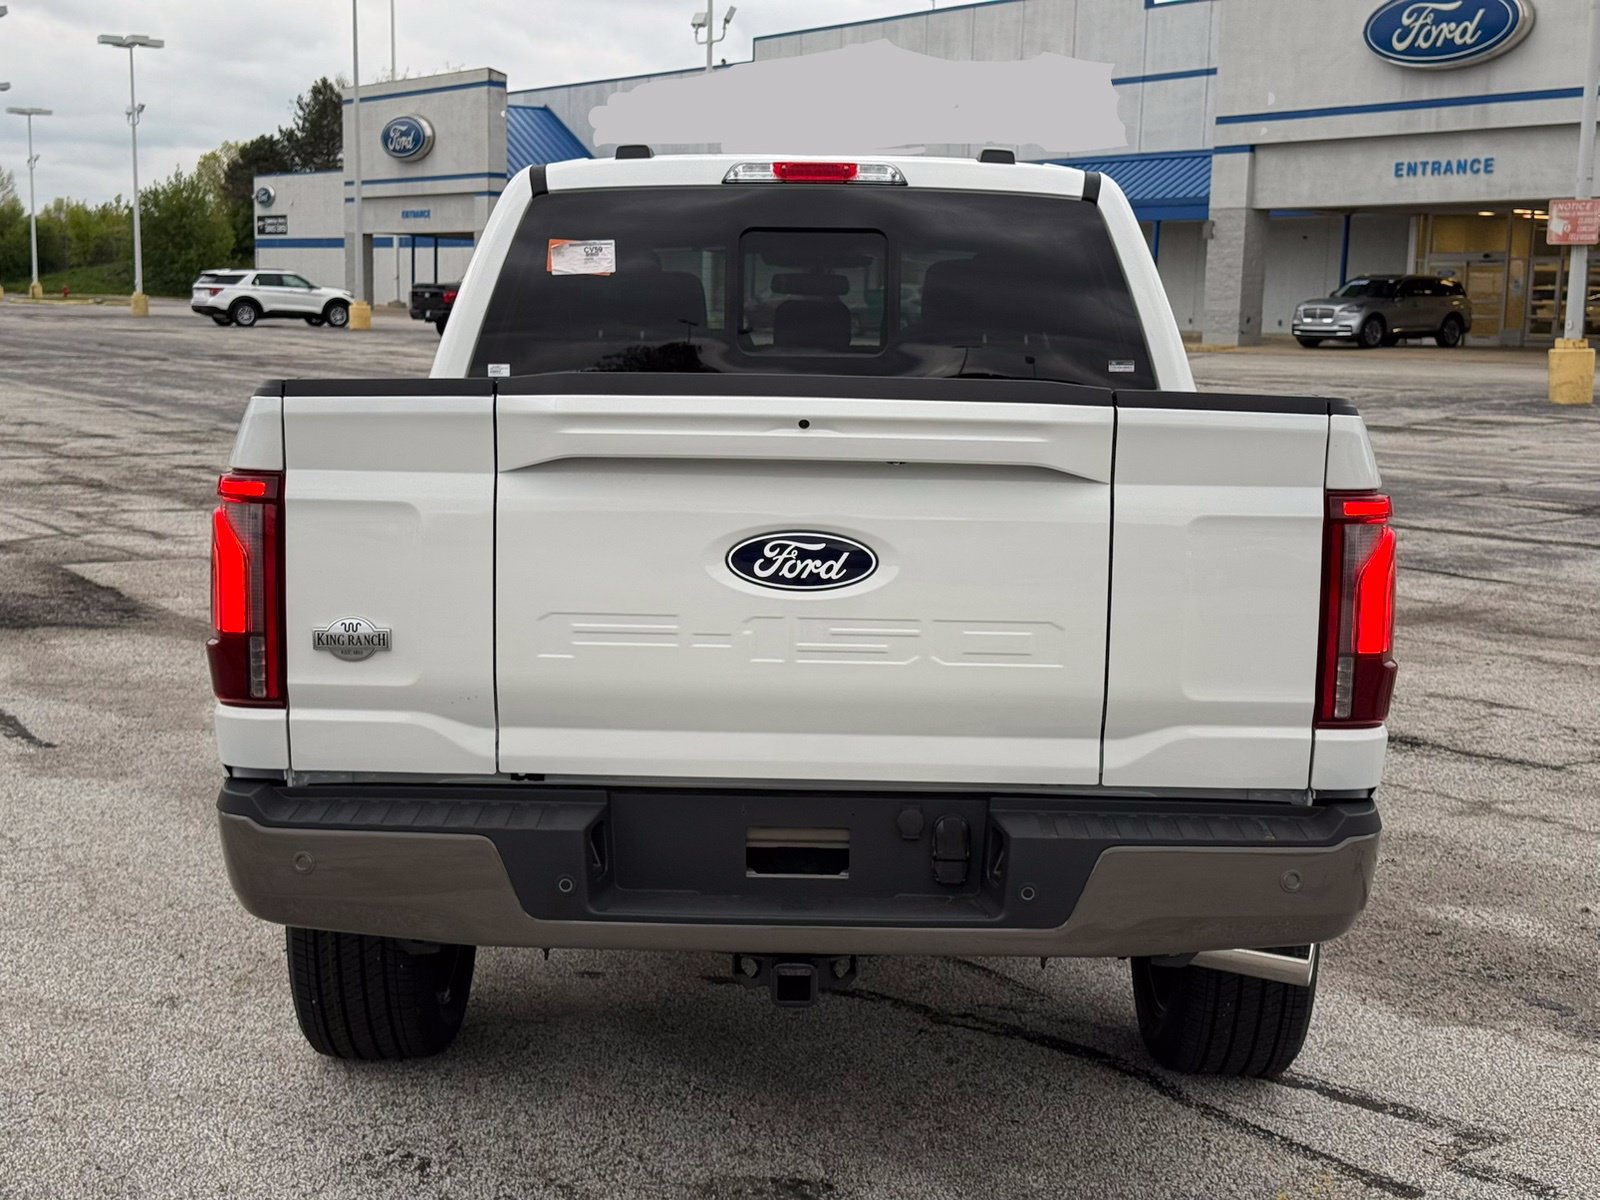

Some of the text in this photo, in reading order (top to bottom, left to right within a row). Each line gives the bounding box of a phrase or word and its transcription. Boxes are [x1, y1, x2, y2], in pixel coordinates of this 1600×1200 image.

[1392, 1, 1485, 51] Ford
[388, 125, 415, 150] Ford
[1394, 157, 1495, 178] ENTRANCE
[1557, 202, 1592, 210] NOTICE
[753, 540, 849, 580] Ford
[317, 633, 386, 646] KING RANCH
[537, 612, 1065, 668] F-150
